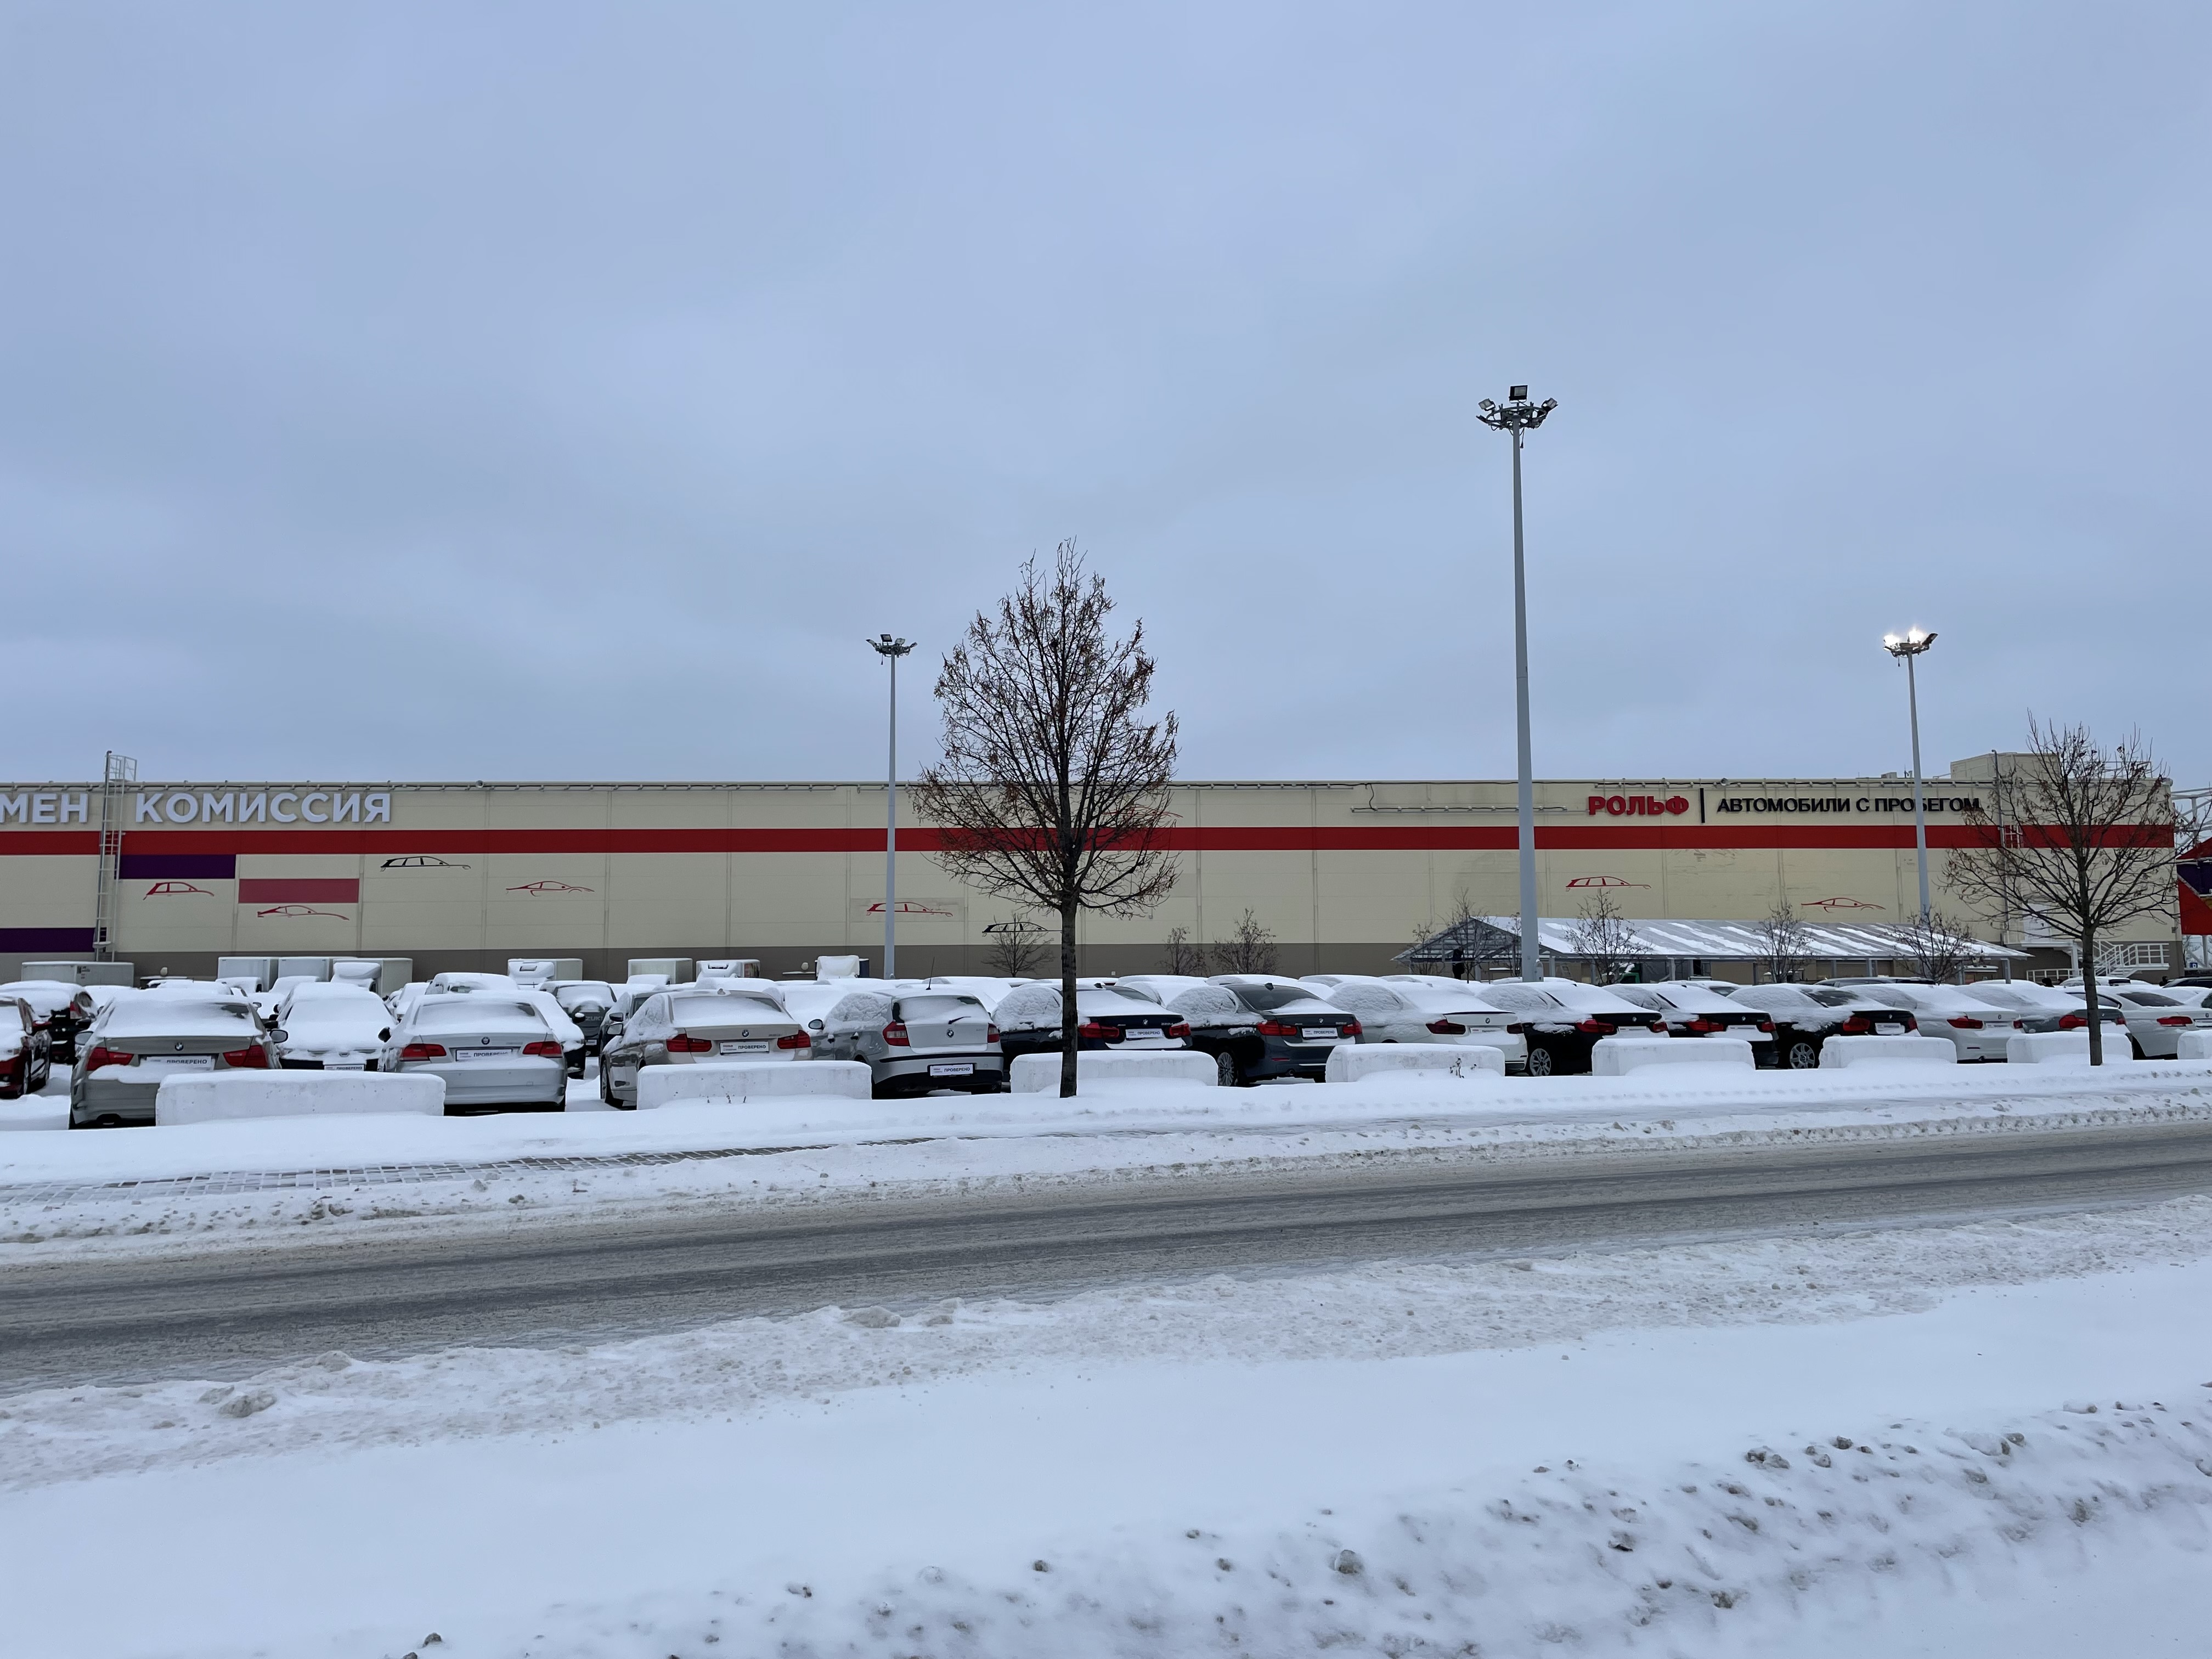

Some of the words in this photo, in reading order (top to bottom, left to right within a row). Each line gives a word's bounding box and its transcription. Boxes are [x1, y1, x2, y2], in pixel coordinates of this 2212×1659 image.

[0, 793, 88, 823] МЕН
[136, 793, 391, 823] КОМИССИЯ
[1588, 795, 1689, 815] РОЛЬФ
[1717, 798, 1850, 812] АВТОМОБИЛИ
[1856, 798, 1870, 812] С
